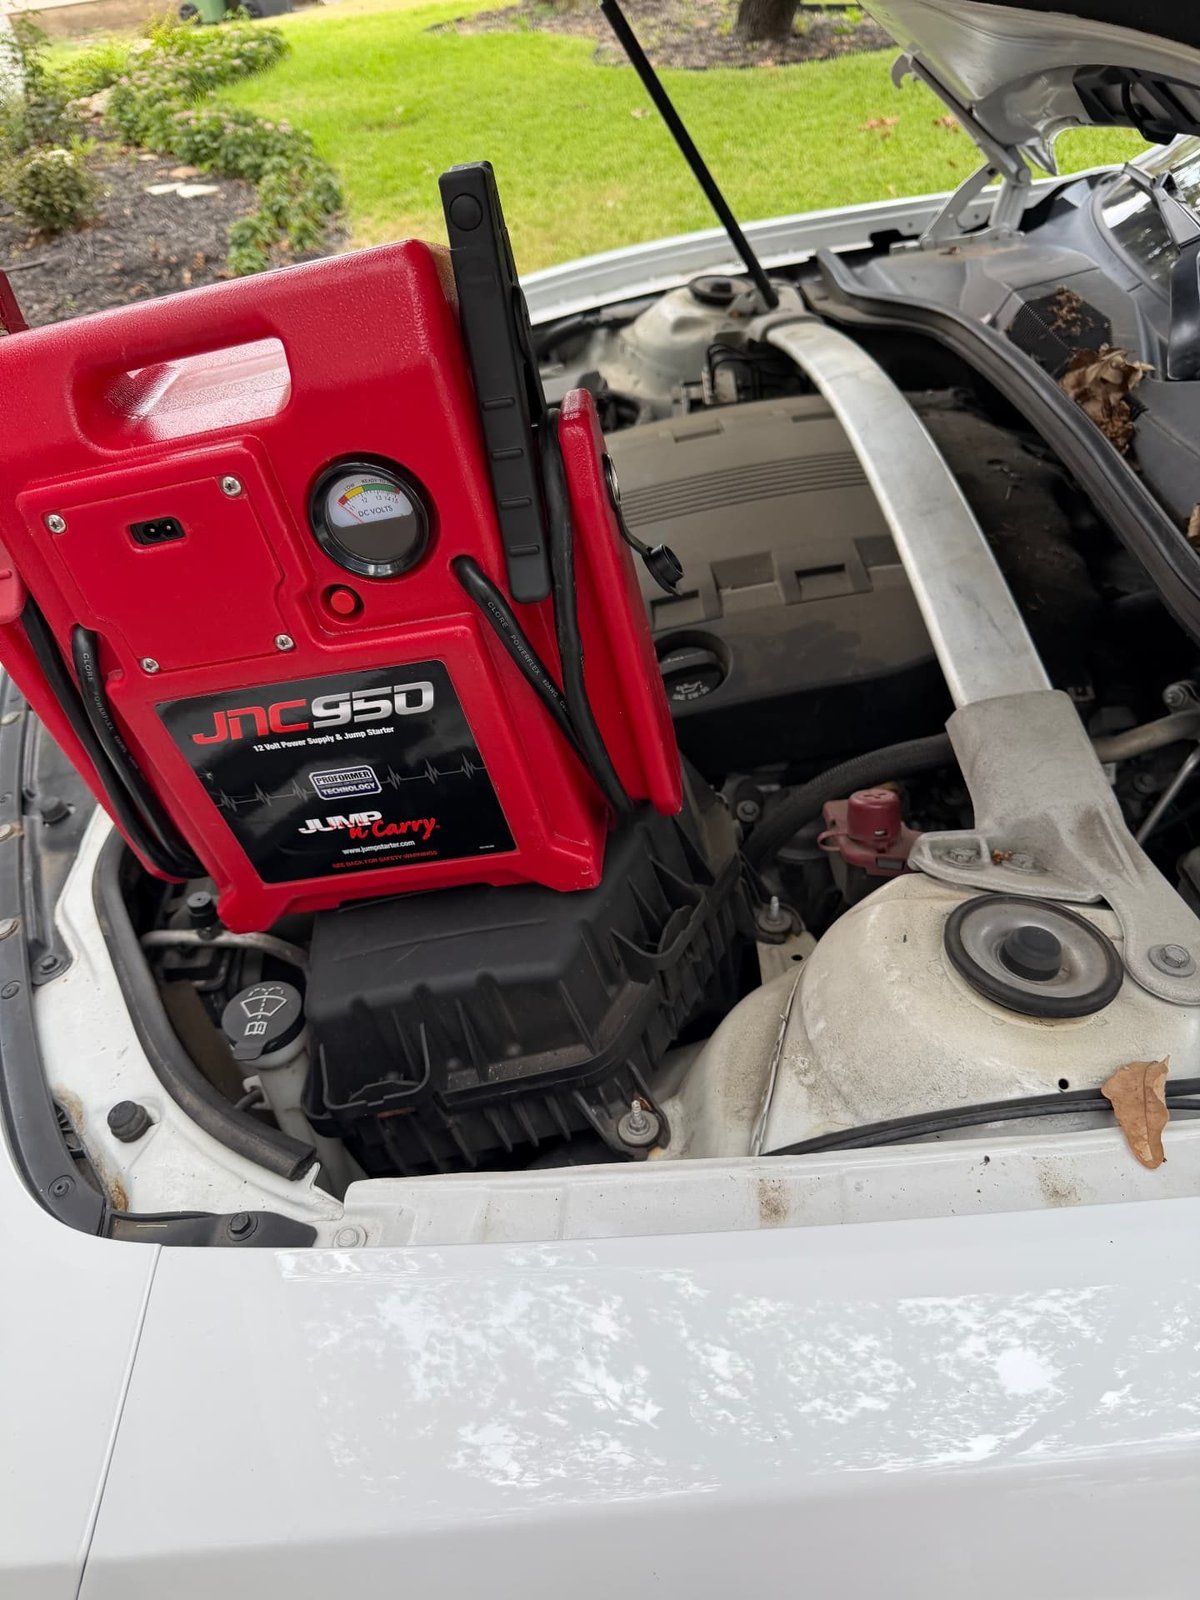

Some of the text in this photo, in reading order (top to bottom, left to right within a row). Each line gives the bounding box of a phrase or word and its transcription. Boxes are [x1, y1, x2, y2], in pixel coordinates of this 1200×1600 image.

[369, 505, 393, 515] VOLTS
[487, 601, 509, 629] CLORE
[511, 634, 540, 675] POWERFLEX
[82, 652, 94, 682] CLORE
[252, 726, 395, 752] 12 Volt Power Supply & Jump Starter
[315, 770, 371, 785] PROFORMER
[320, 782, 377, 797] TECHNOLOGY
[298, 810, 383, 834] JUMP
[371, 817, 436, 840] Carry
[341, 840, 416, 855] www.jumpstarter.com
[332, 850, 438, 869] SEE BACK FOR SAFETY WARNINGS
